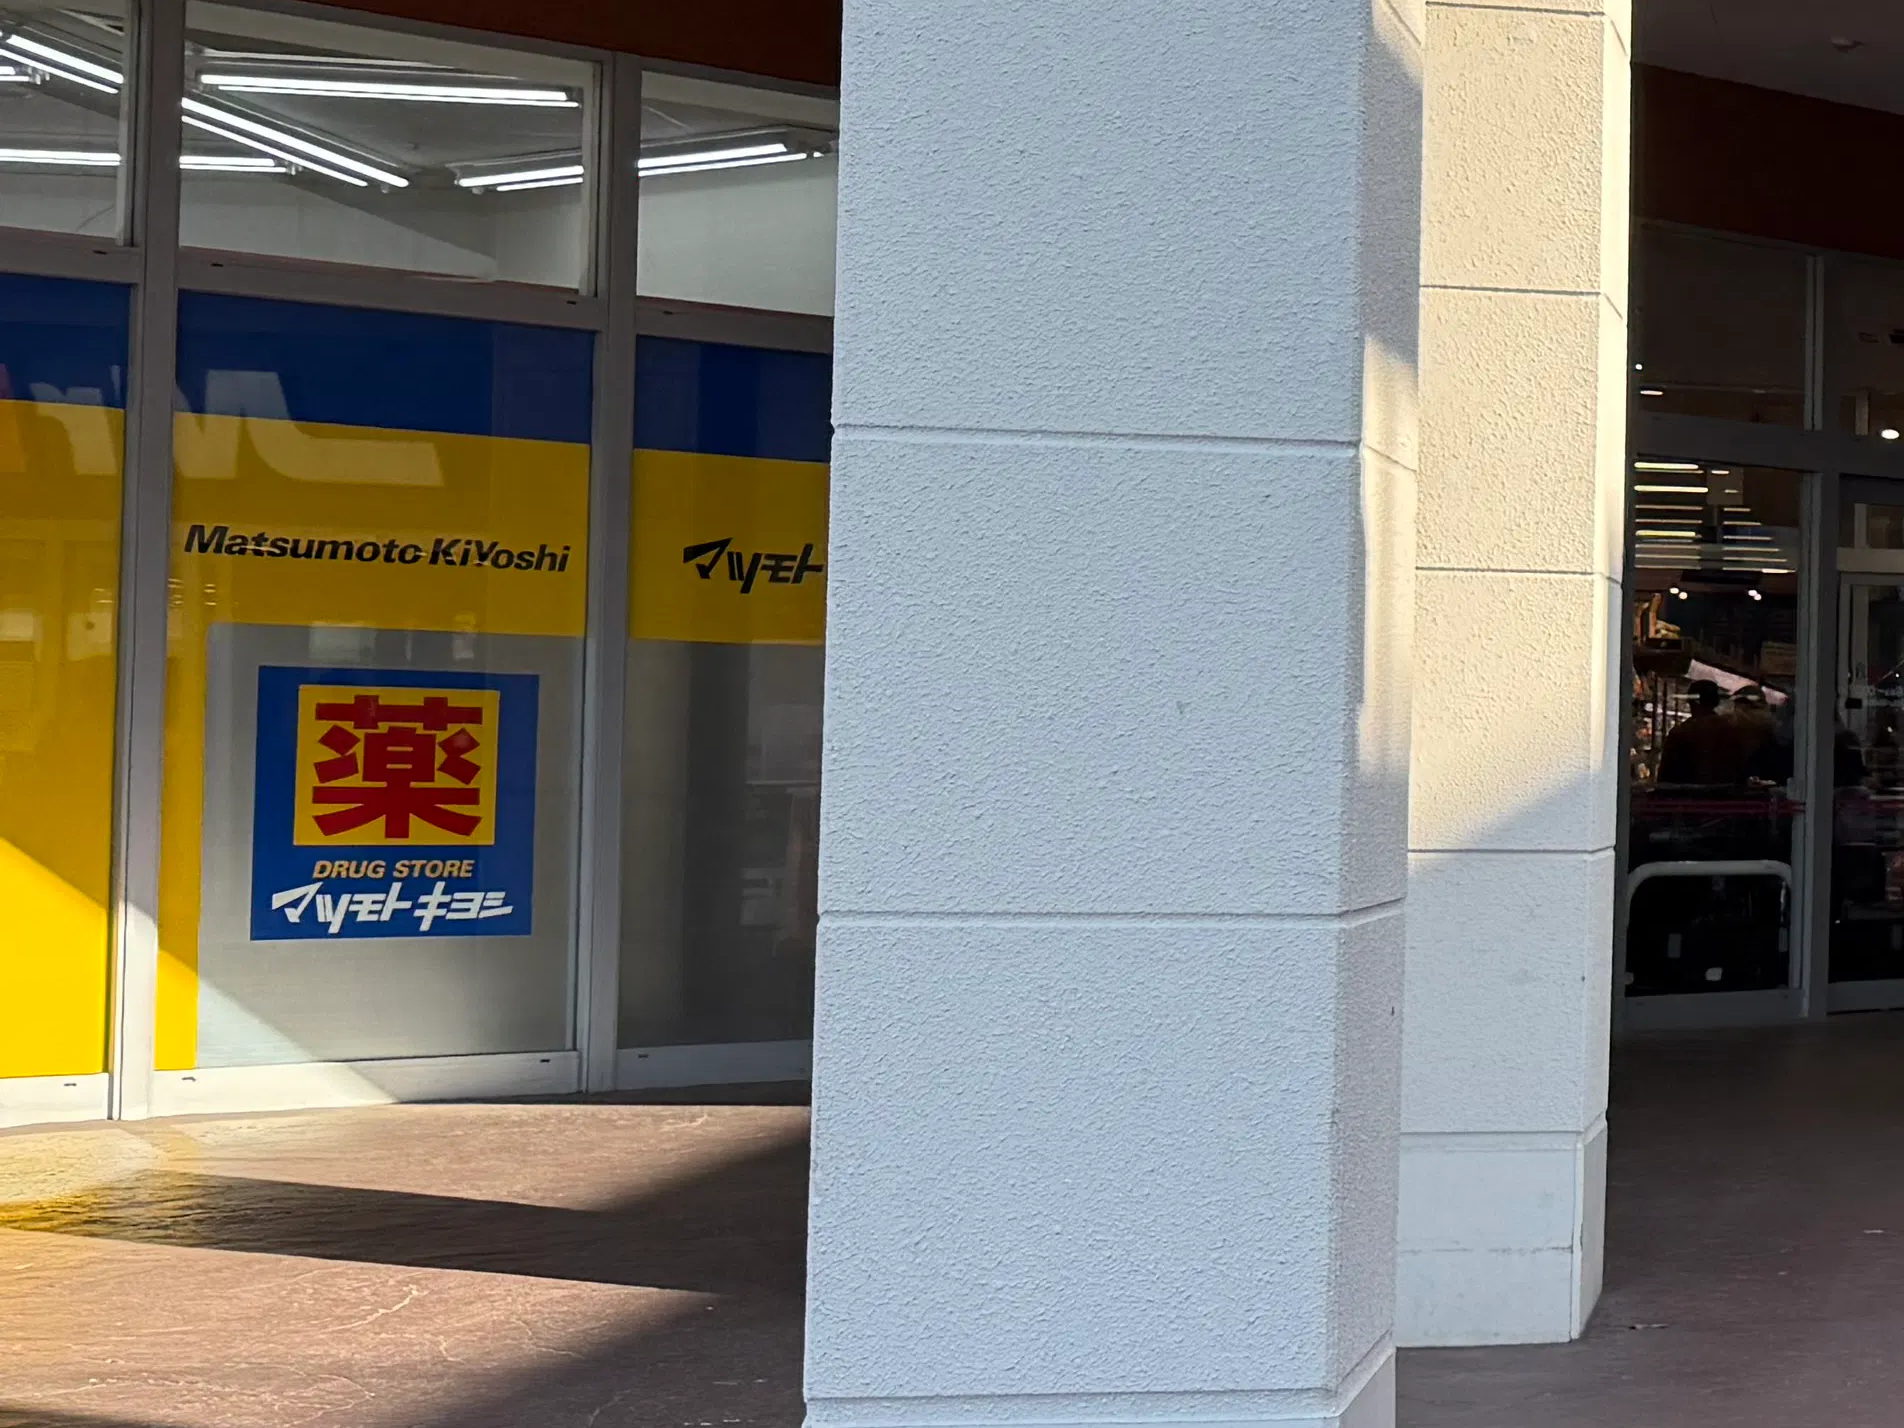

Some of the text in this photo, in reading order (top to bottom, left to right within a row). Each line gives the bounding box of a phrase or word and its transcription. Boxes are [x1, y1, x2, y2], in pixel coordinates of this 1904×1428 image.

[184, 523, 572, 572] Matsumoto KiYoshi
[311, 694, 483, 840] 薬
[312, 859, 475, 880] DRUG STORE
[271, 880, 514, 934] マツモトキヨシ
